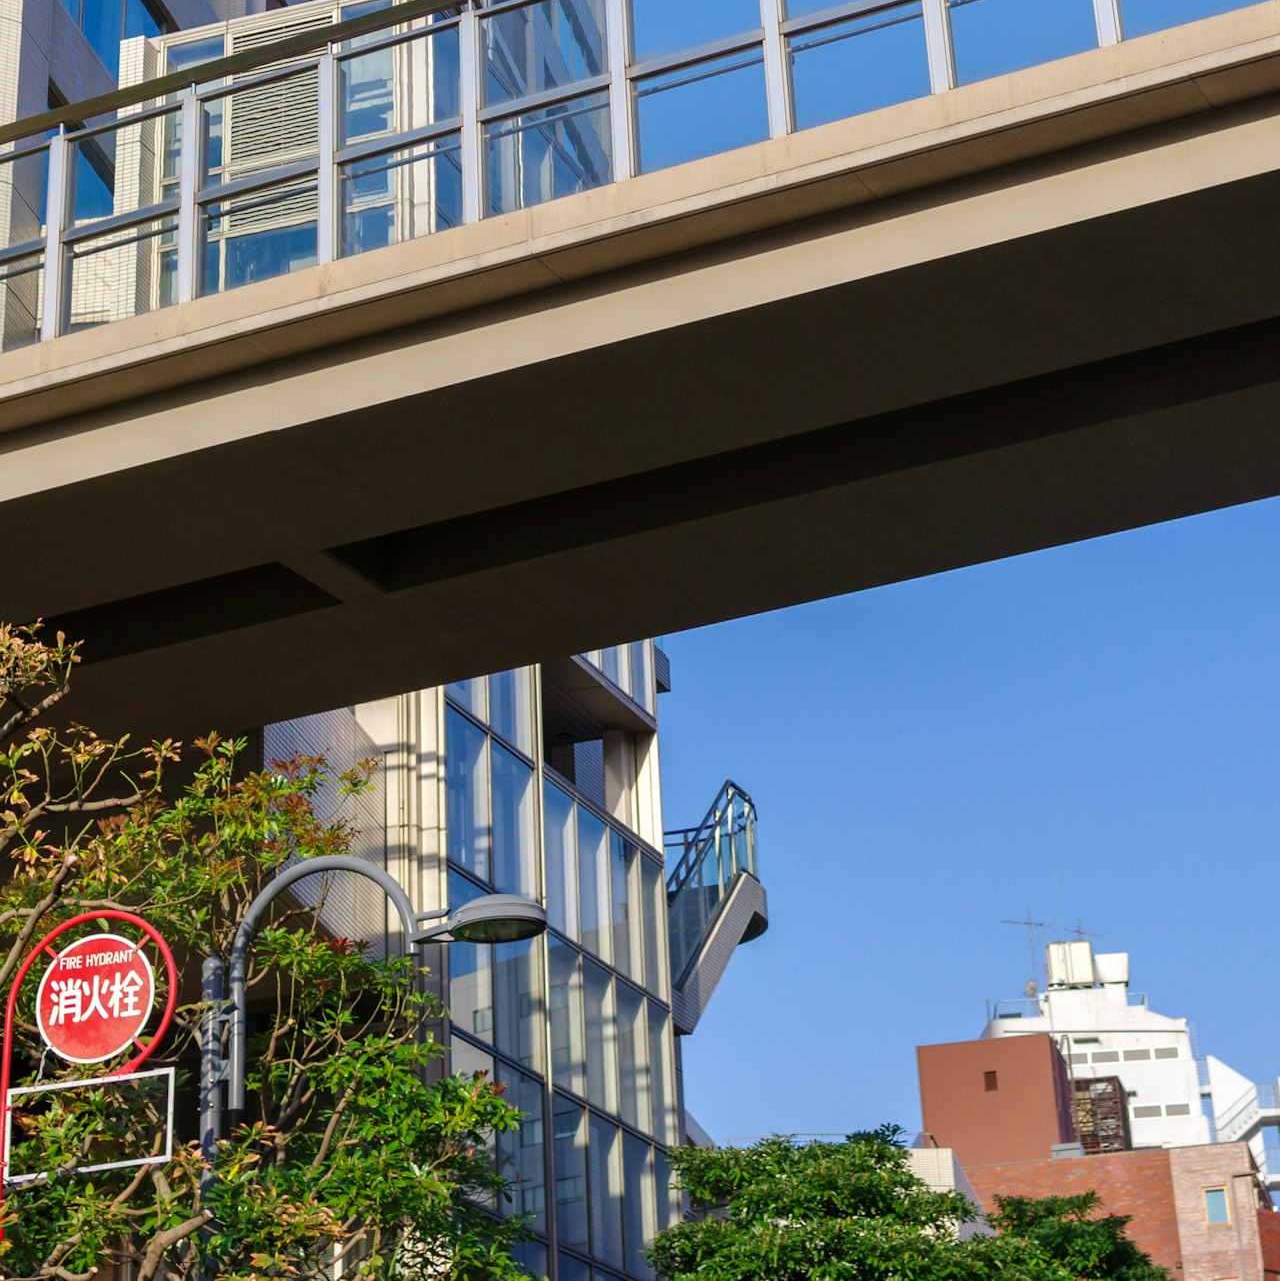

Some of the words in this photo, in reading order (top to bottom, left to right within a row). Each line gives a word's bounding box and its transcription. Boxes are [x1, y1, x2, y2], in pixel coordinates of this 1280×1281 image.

[60, 956, 82, 970] FIRE
[86, 950, 133, 967] HYDRANT
[49, 970, 143, 1026] 消火栓
